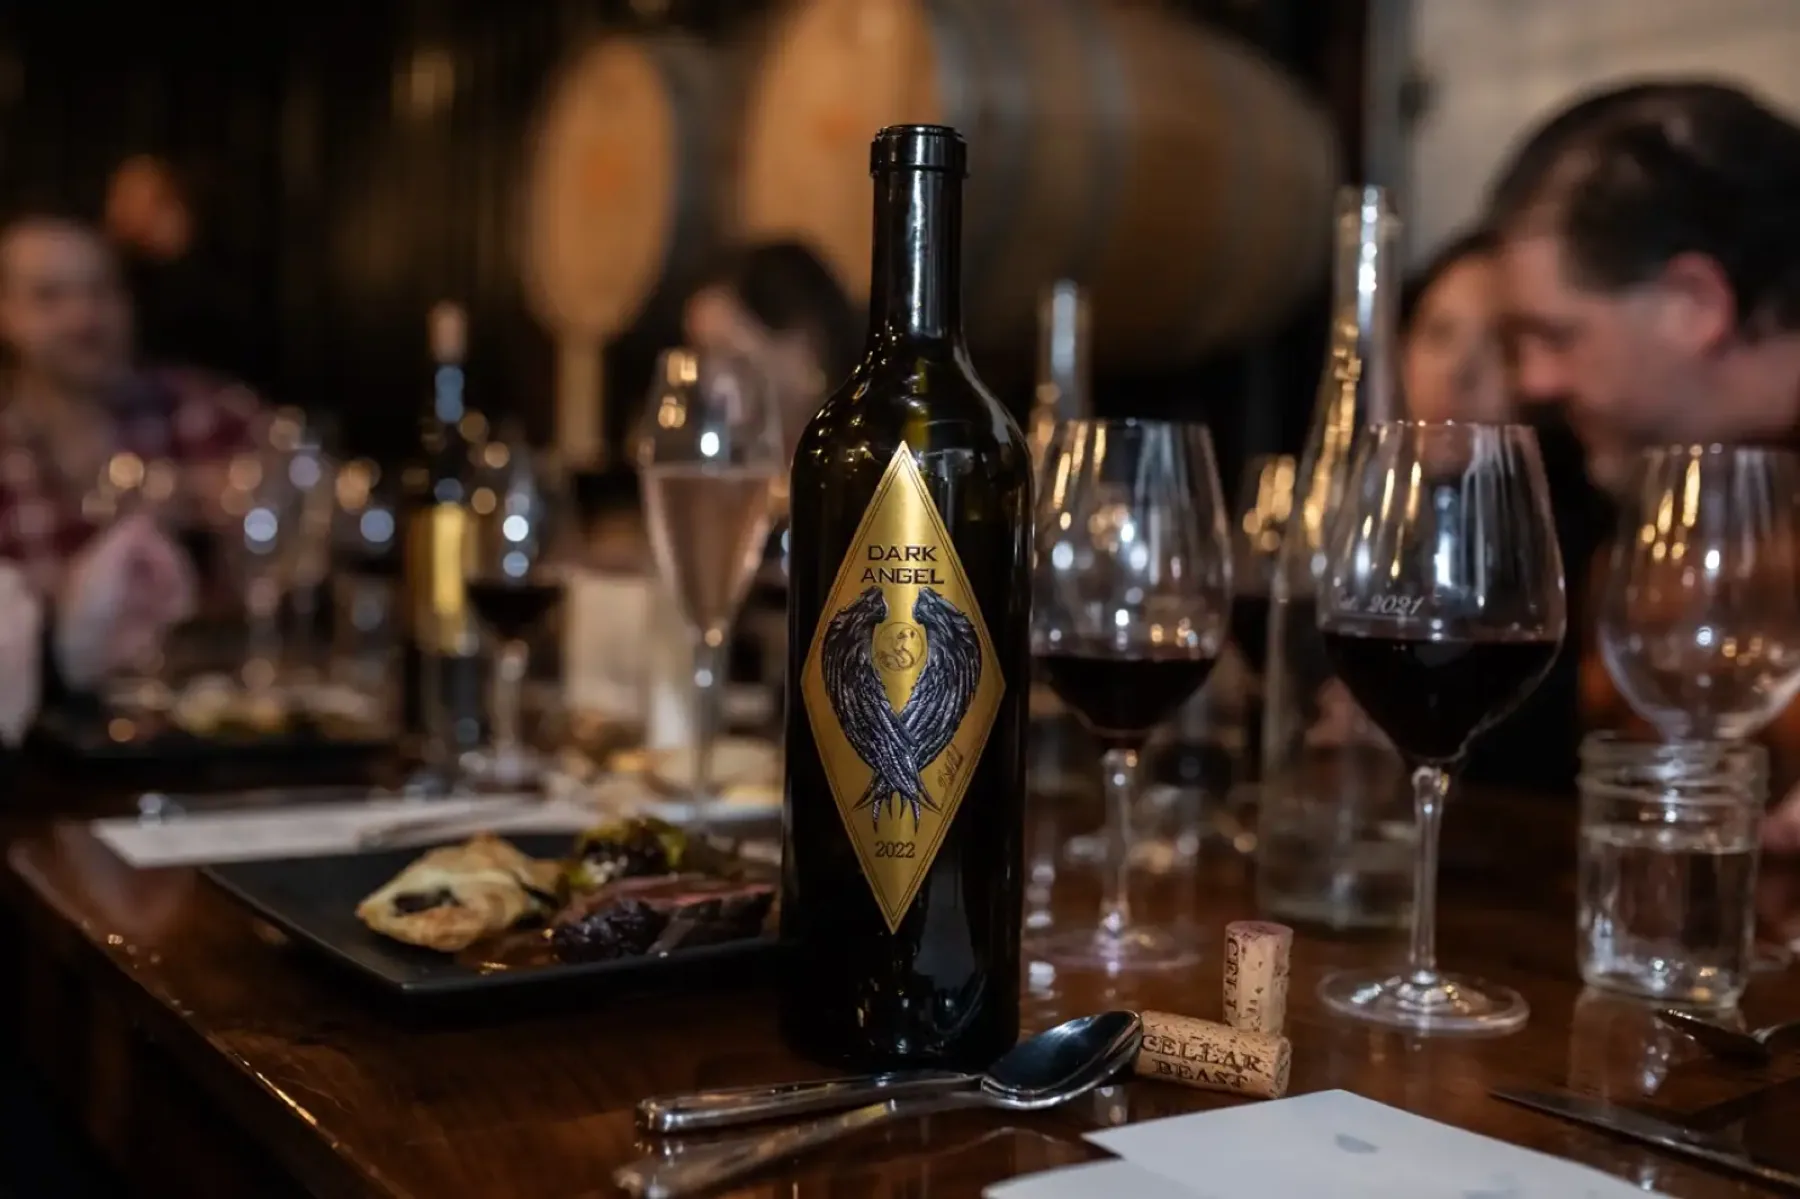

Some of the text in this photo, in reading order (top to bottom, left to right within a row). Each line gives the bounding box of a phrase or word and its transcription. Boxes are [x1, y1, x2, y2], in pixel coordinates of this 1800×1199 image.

[867, 545, 937, 562] DARK
[860, 567, 944, 585] ANGEL
[1366, 594, 1425, 615] 2021
[875, 841, 916, 858] 2022
[1141, 1035, 1263, 1073] CELLAR
[1153, 1059, 1248, 1087] BEAST
